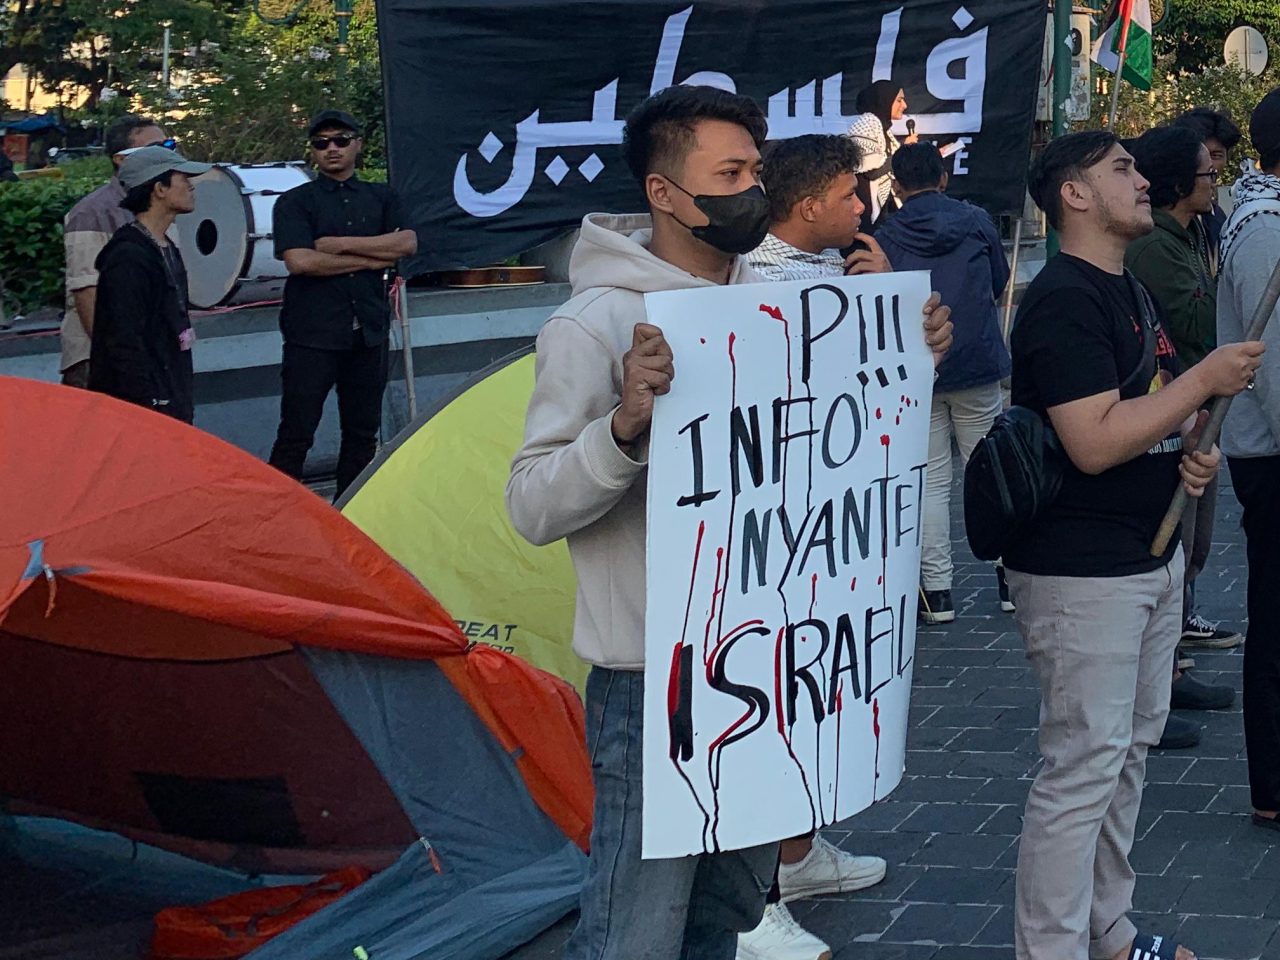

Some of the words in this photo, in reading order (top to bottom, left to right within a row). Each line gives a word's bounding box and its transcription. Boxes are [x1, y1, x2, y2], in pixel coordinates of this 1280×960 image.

[801, 283, 908, 387] P!!!
[676, 392, 864, 508] INFO
[740, 464, 928, 595] NYANTET
[667, 595, 912, 764] ISRAEL
